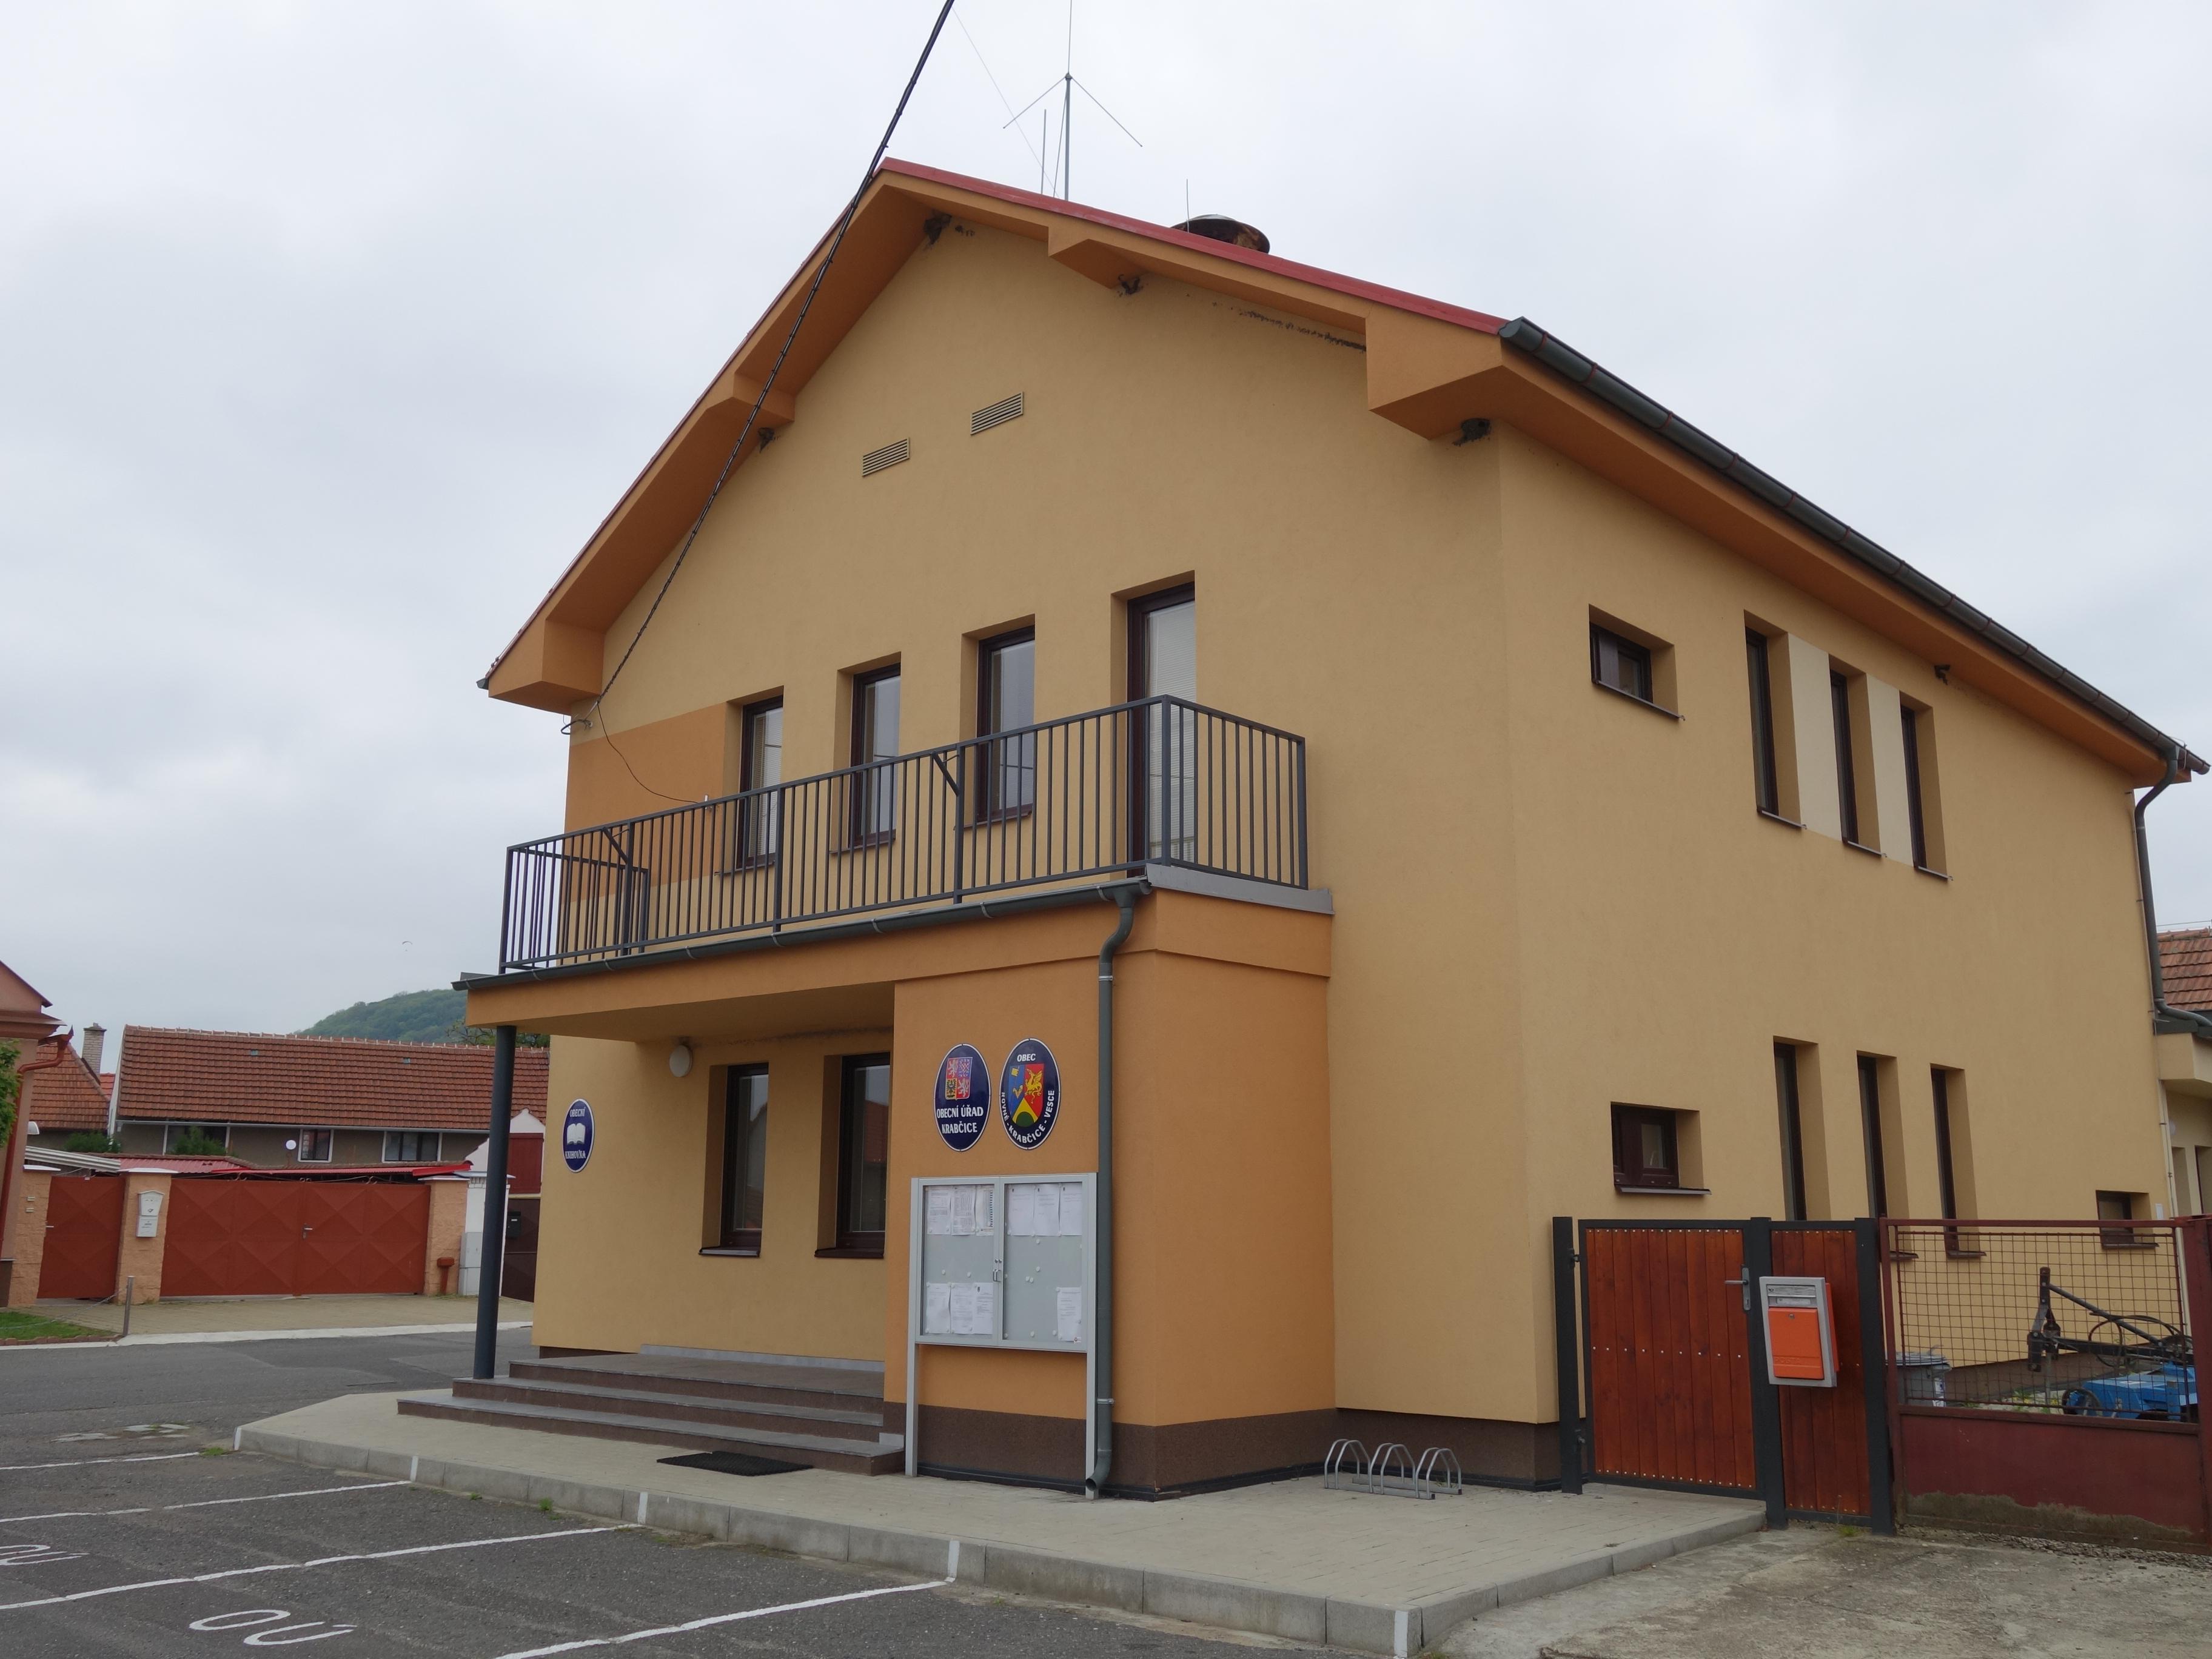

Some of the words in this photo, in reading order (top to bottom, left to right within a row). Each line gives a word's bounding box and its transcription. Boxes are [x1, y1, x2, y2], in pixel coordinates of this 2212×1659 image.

[1017, 1053, 1036, 1062] OBEC
[569, 1107, 586, 1118] OBECNÍ
[936, 1105, 959, 1118] OBECNÍ
[960, 1104, 984, 1117] ÚŘAD
[1000, 1092, 1009, 1122] ROVNÉ
[1008, 1124, 1046, 1144] KRABČICE
[1045, 1090, 1054, 1118] VESCE
[941, 1121, 978, 1134] KRABČICE
[565, 1150, 586, 1159] KNIHOVNA
